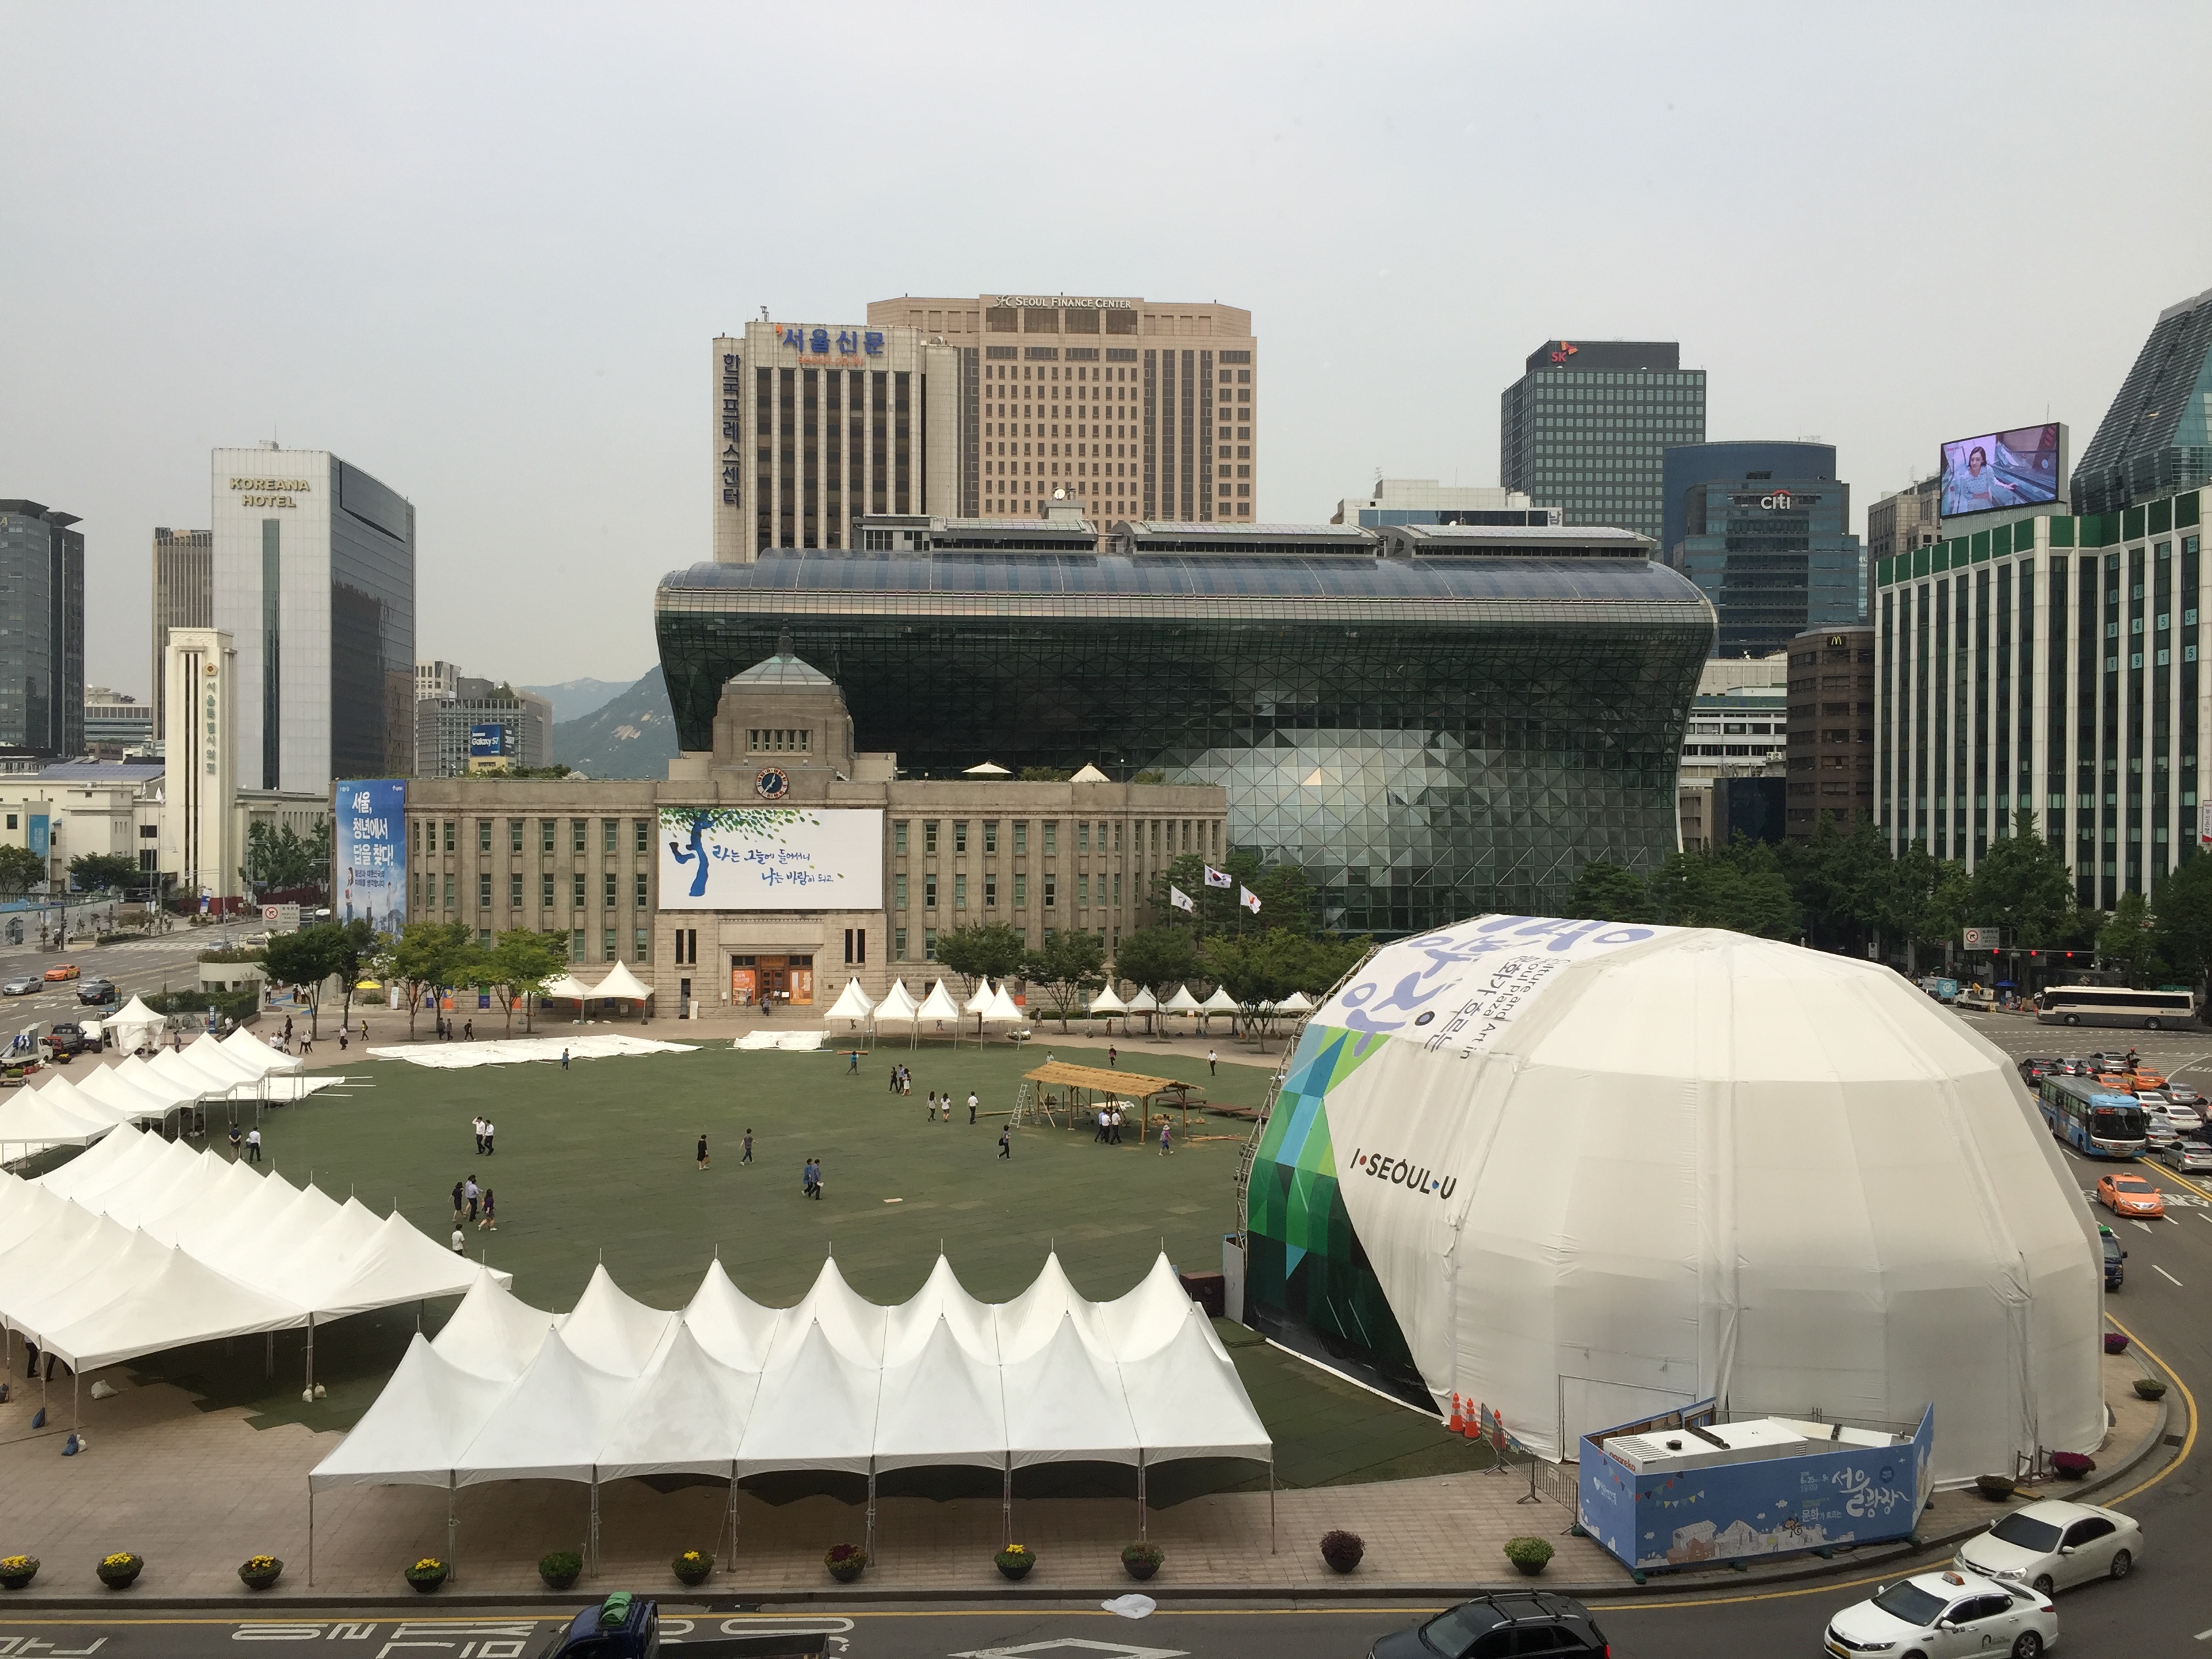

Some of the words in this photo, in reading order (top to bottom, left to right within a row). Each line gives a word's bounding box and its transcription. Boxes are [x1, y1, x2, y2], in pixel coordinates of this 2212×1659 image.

[1015, 295, 1048, 307] SEOUL
[1051, 296, 1094, 308] FINANCE
[1095, 298, 1132, 309] CENTER
[783, 328, 885, 355] 서울신문
[1551, 351, 1567, 363] SK
[722, 352, 741, 508] 한국프레스센터
[229, 477, 310, 492] KOREANA
[241, 494, 297, 508] HOTEL
[1761, 492, 1790, 510] citi
[472, 737, 492, 747] Galaxy
[491, 737, 499, 745] S7
[352, 817, 388, 840] 청년에서
[353, 843, 372, 865] 답을
[373, 843, 394, 867] 찾다!
[743, 848, 775, 865] 그늘에
[762, 867, 783, 886] 나는
[785, 870, 815, 886] 바람이
[1495, 996, 1521, 1021] and
[1471, 1022, 1496, 1043] Art
[1460, 1046, 1477, 1059] in
